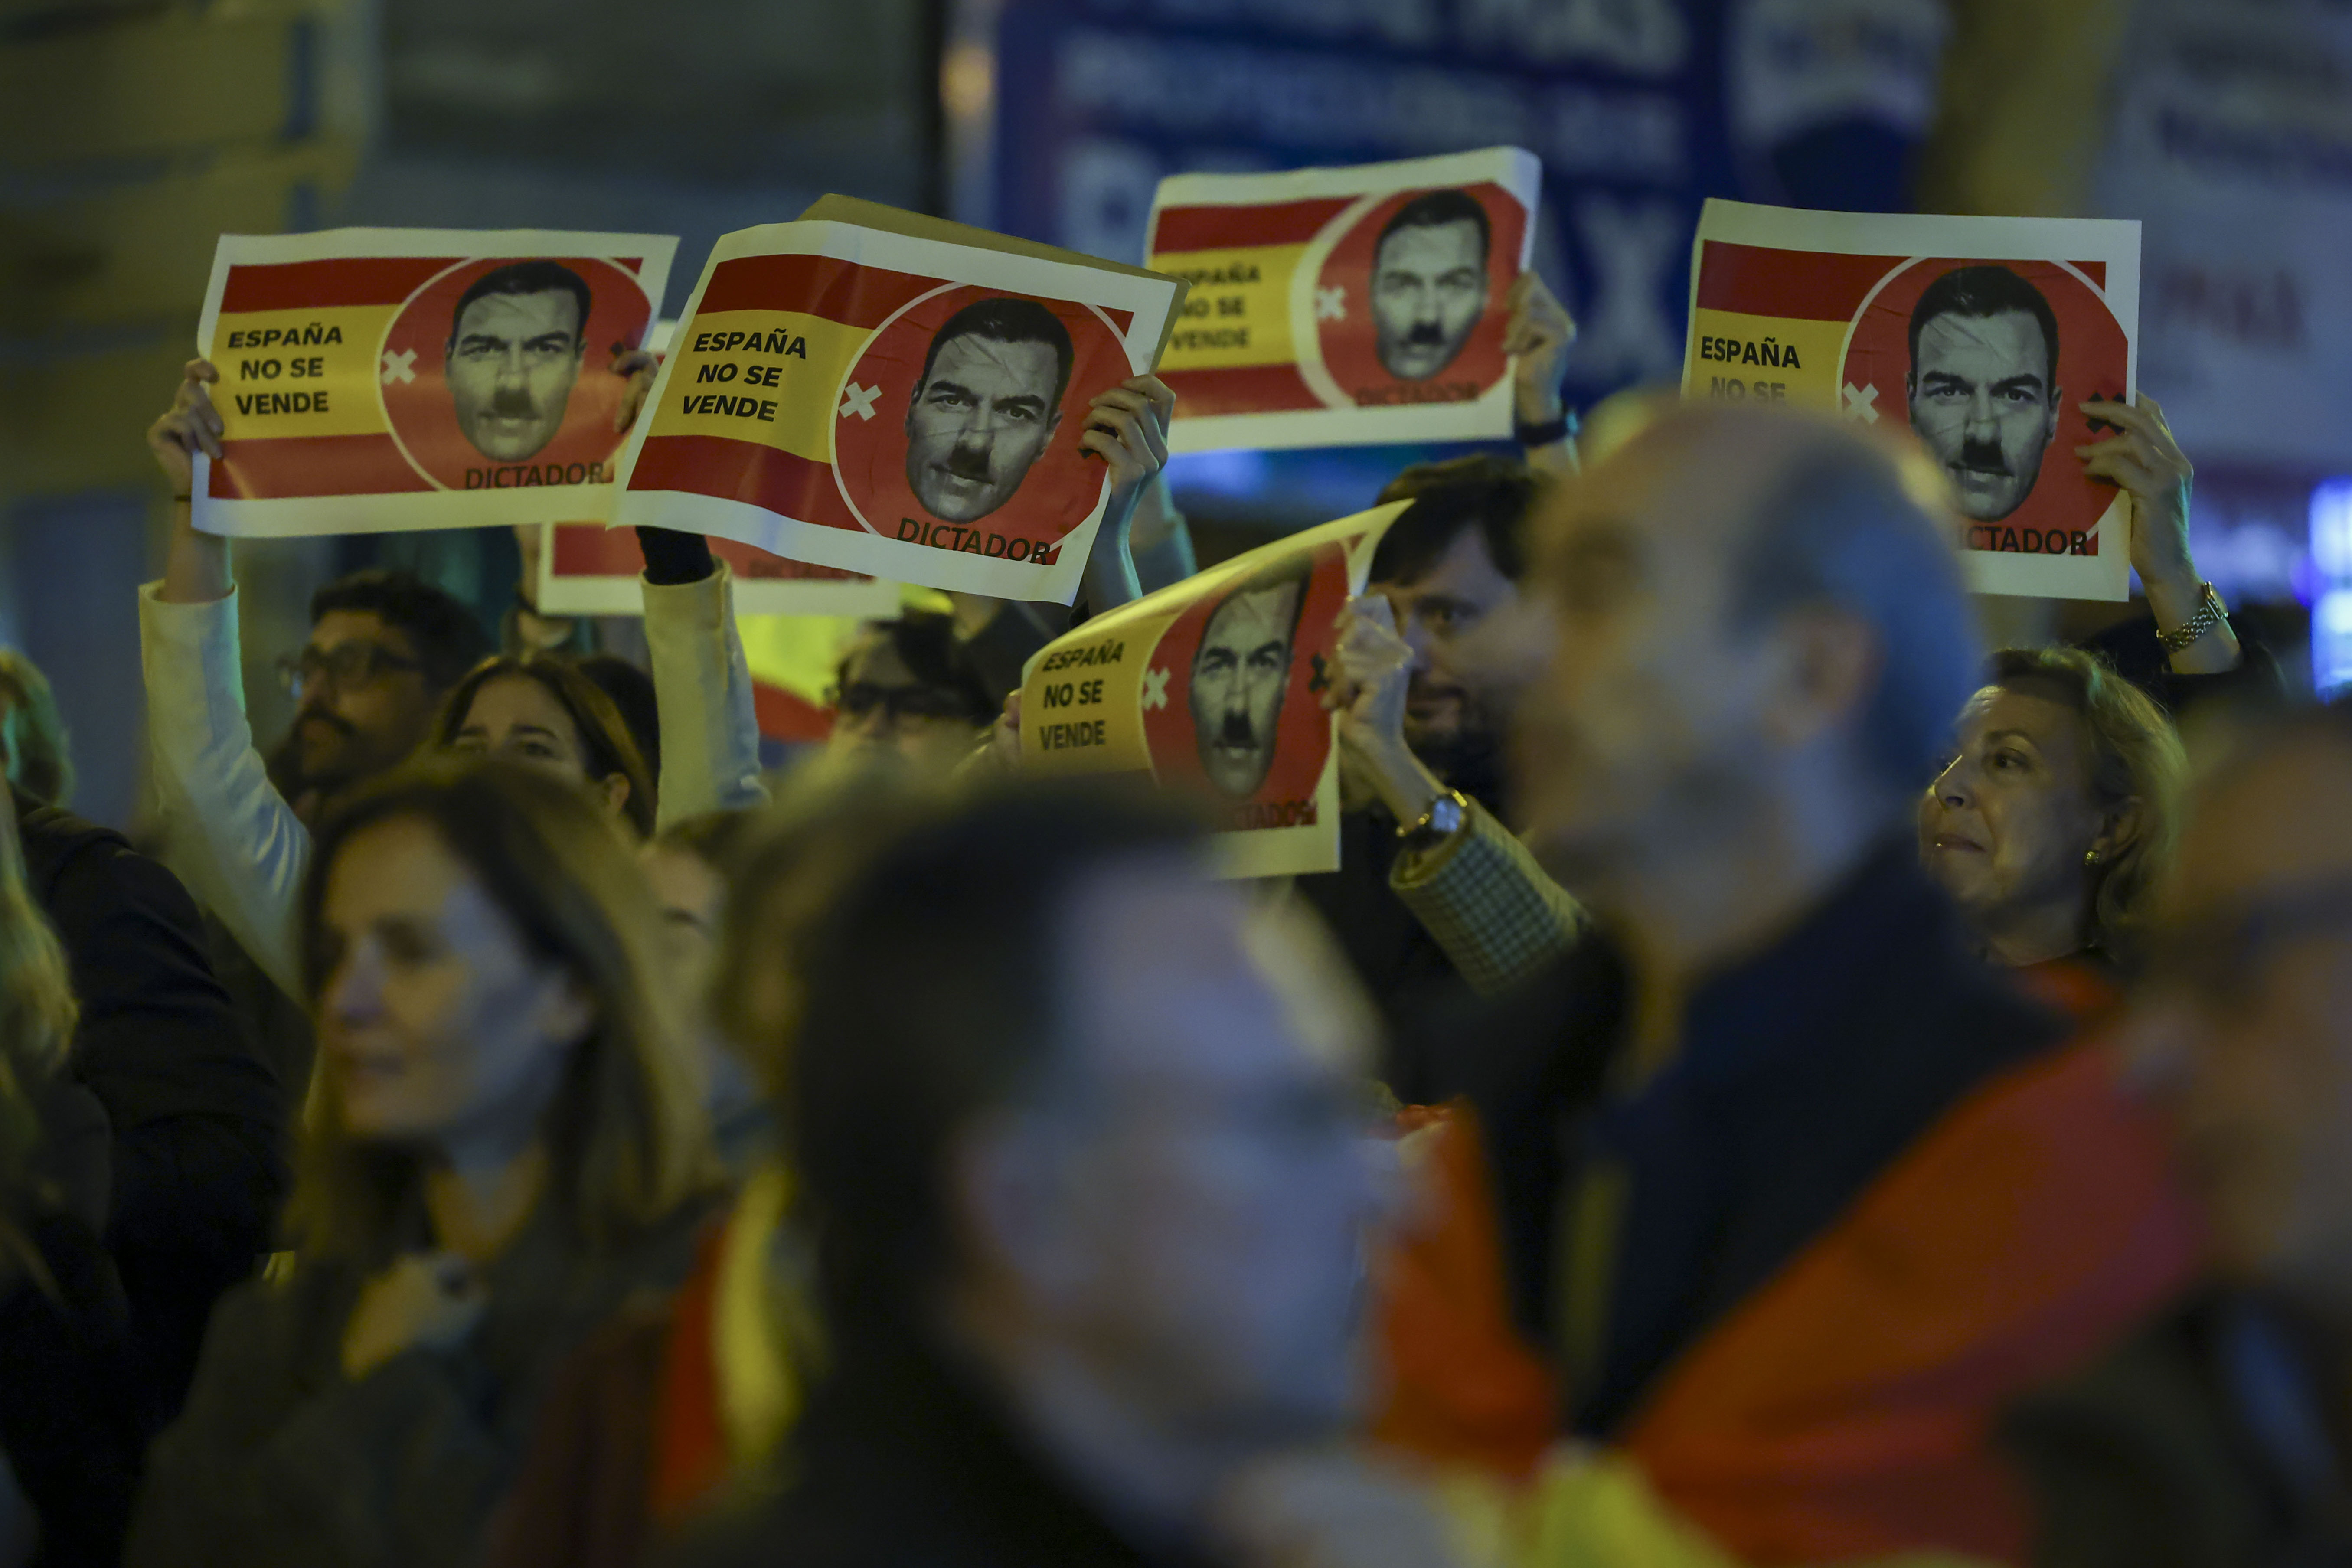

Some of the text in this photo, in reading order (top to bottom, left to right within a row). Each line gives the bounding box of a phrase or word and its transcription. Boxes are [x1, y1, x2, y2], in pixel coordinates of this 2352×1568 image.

[228, 321, 343, 348] ESPAÑA
[693, 328, 807, 359] ESPAÑA
[1701, 336, 1801, 369] ESPAÑA
[241, 357, 323, 380] NO SE
[697, 363, 783, 387] NO SE
[235, 391, 329, 415] VENDE
[1711, 376, 1786, 404] NO SE
[683, 395, 778, 422] VENDE
[465, 462, 605, 490] DICTADOR
[896, 517, 1052, 566] DICTADOR
[1043, 640, 1124, 671] ESPAÑA
[1044, 680, 1104, 709] NO SE
[1040, 721, 1105, 750] VENDE
